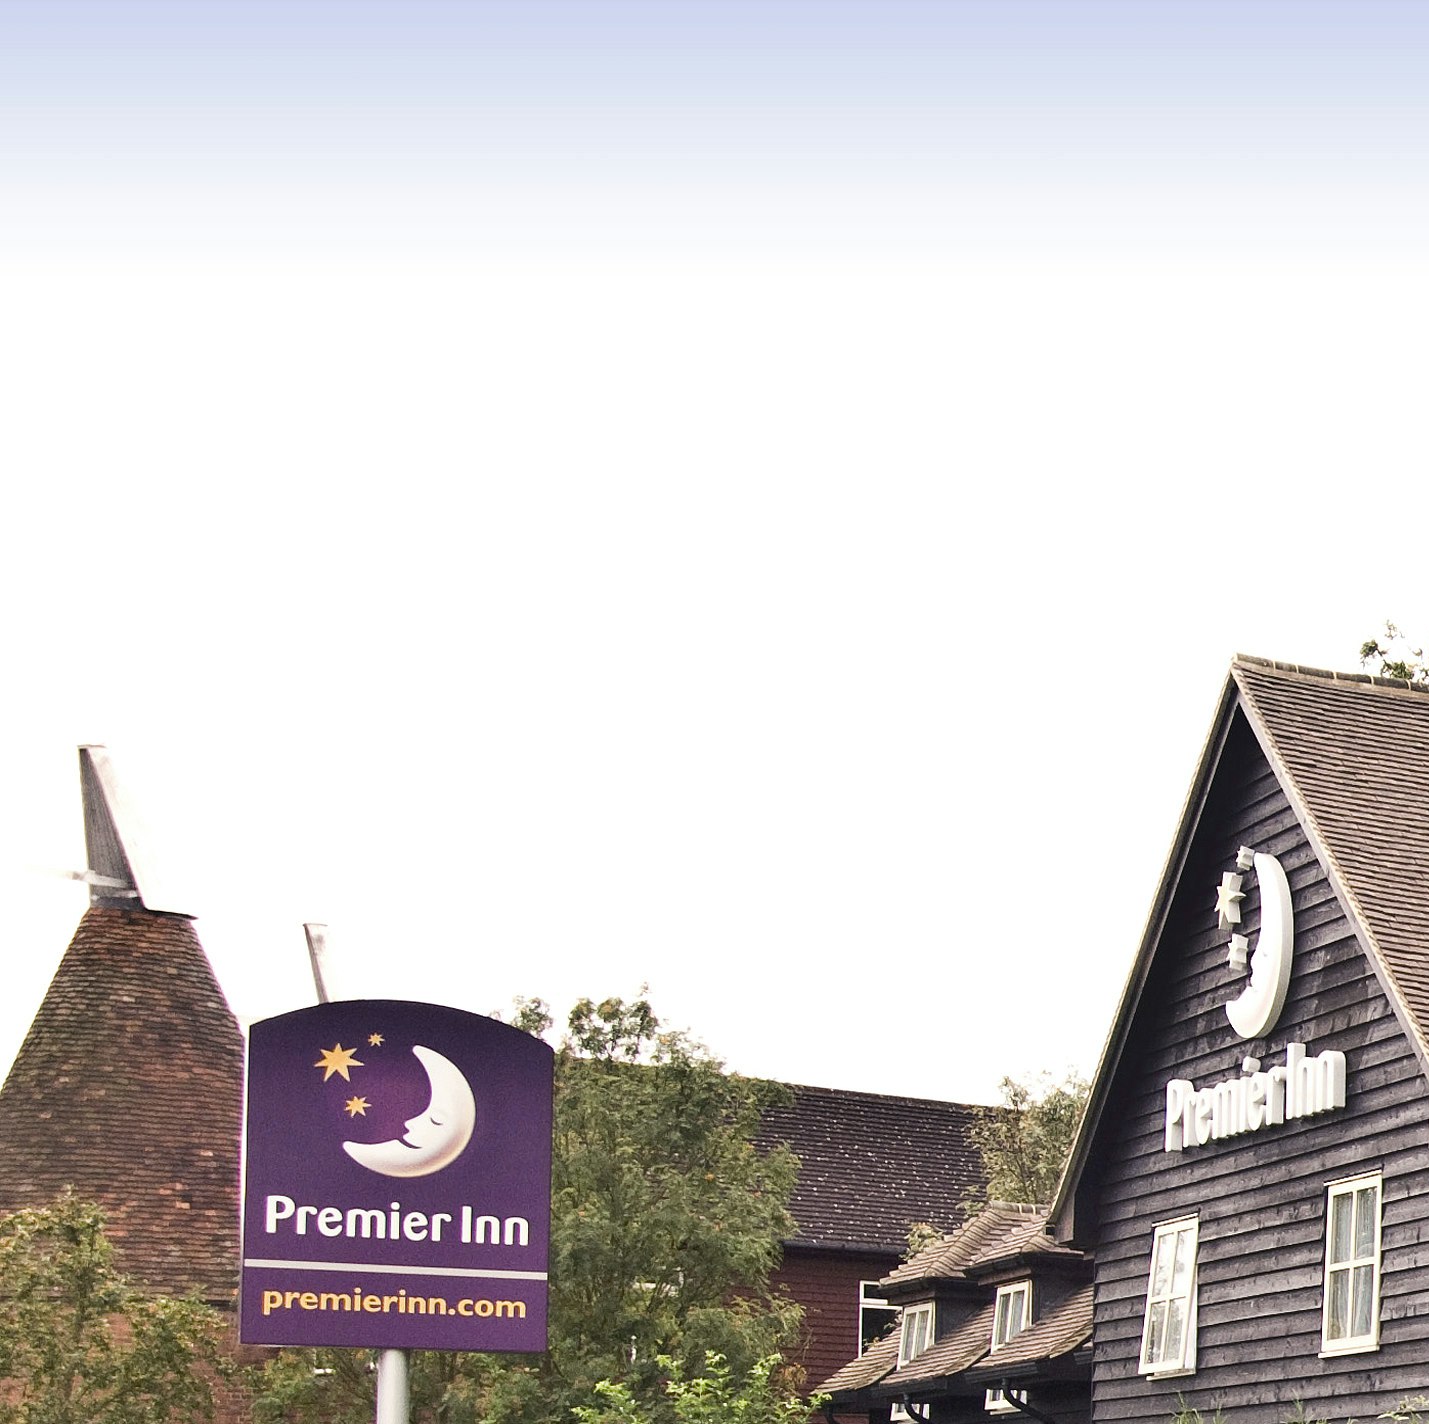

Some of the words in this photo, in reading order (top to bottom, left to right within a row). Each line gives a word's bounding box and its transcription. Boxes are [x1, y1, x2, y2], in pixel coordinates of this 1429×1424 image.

[1165, 1056, 1287, 1153] Premier
[1286, 1042, 1347, 1121] Inn
[265, 1195, 452, 1242] Premier
[461, 1205, 529, 1246] Inn
[262, 1287, 527, 1319] premierinn.com
